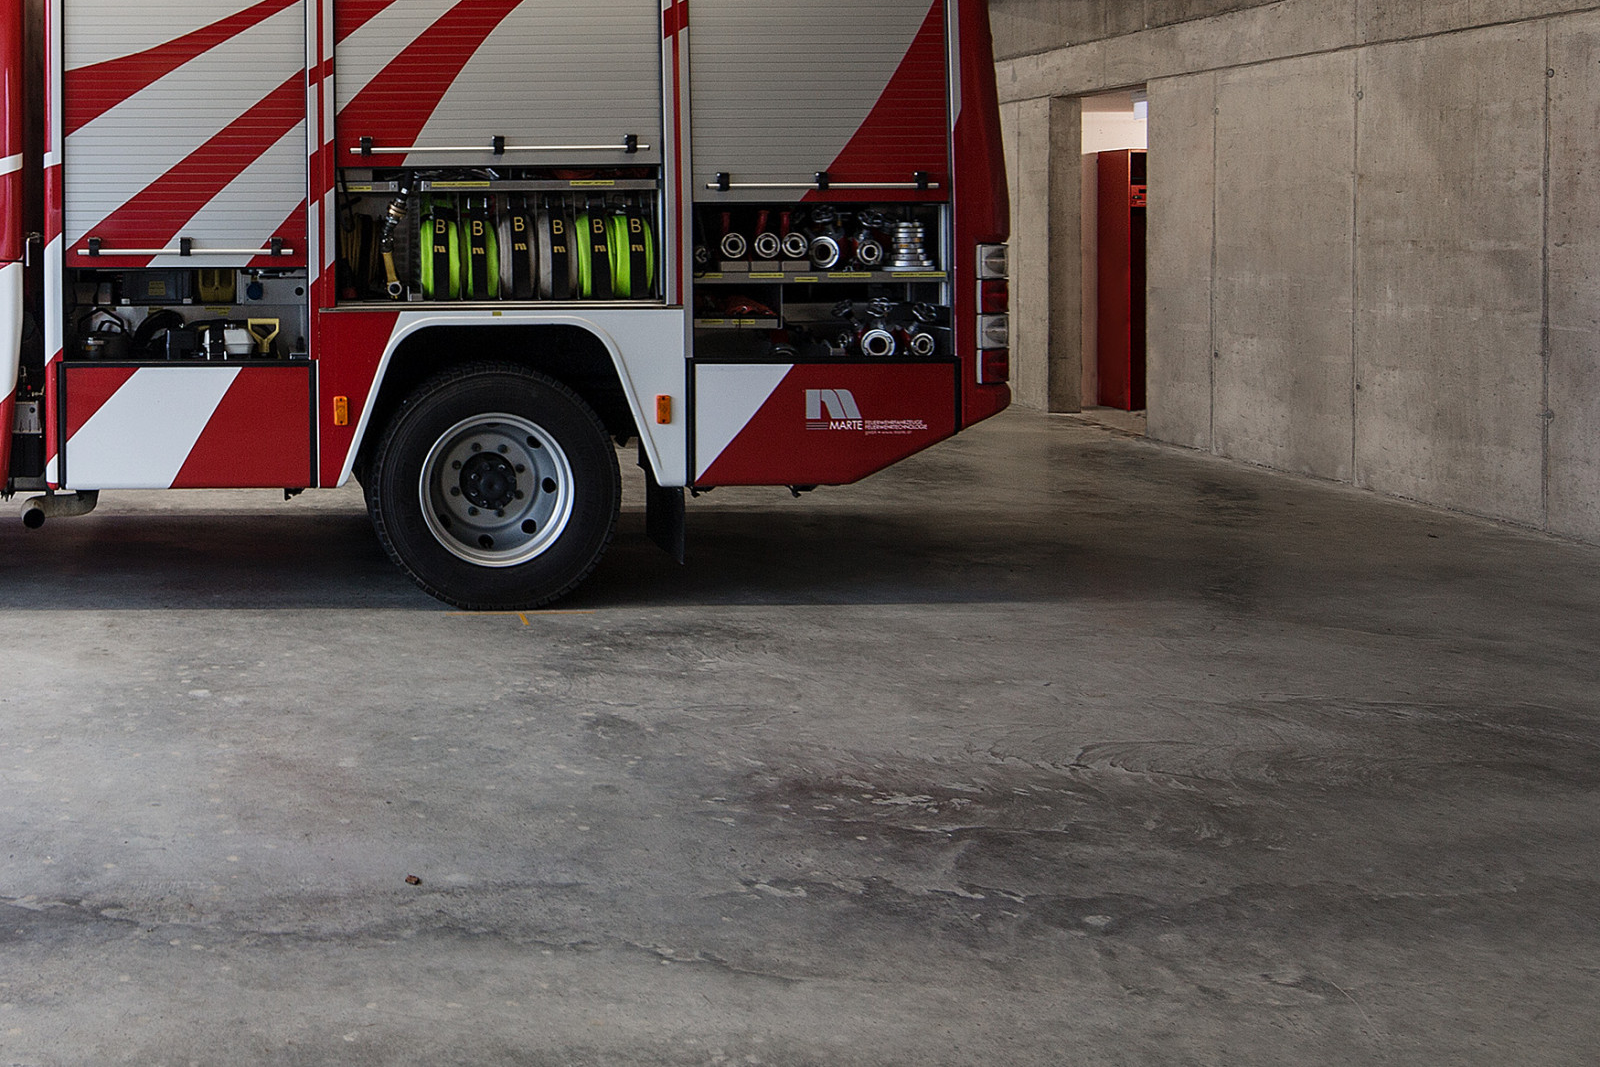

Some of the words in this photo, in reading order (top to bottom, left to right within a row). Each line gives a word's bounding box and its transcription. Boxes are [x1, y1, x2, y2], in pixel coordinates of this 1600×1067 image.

[435, 219, 446, 234] B
[472, 220, 484, 236] B
[513, 216, 525, 232] B
[553, 219, 564, 234] B
[593, 219, 604, 234] B
[630, 218, 642, 233] B
[829, 421, 864, 430] MARTE
